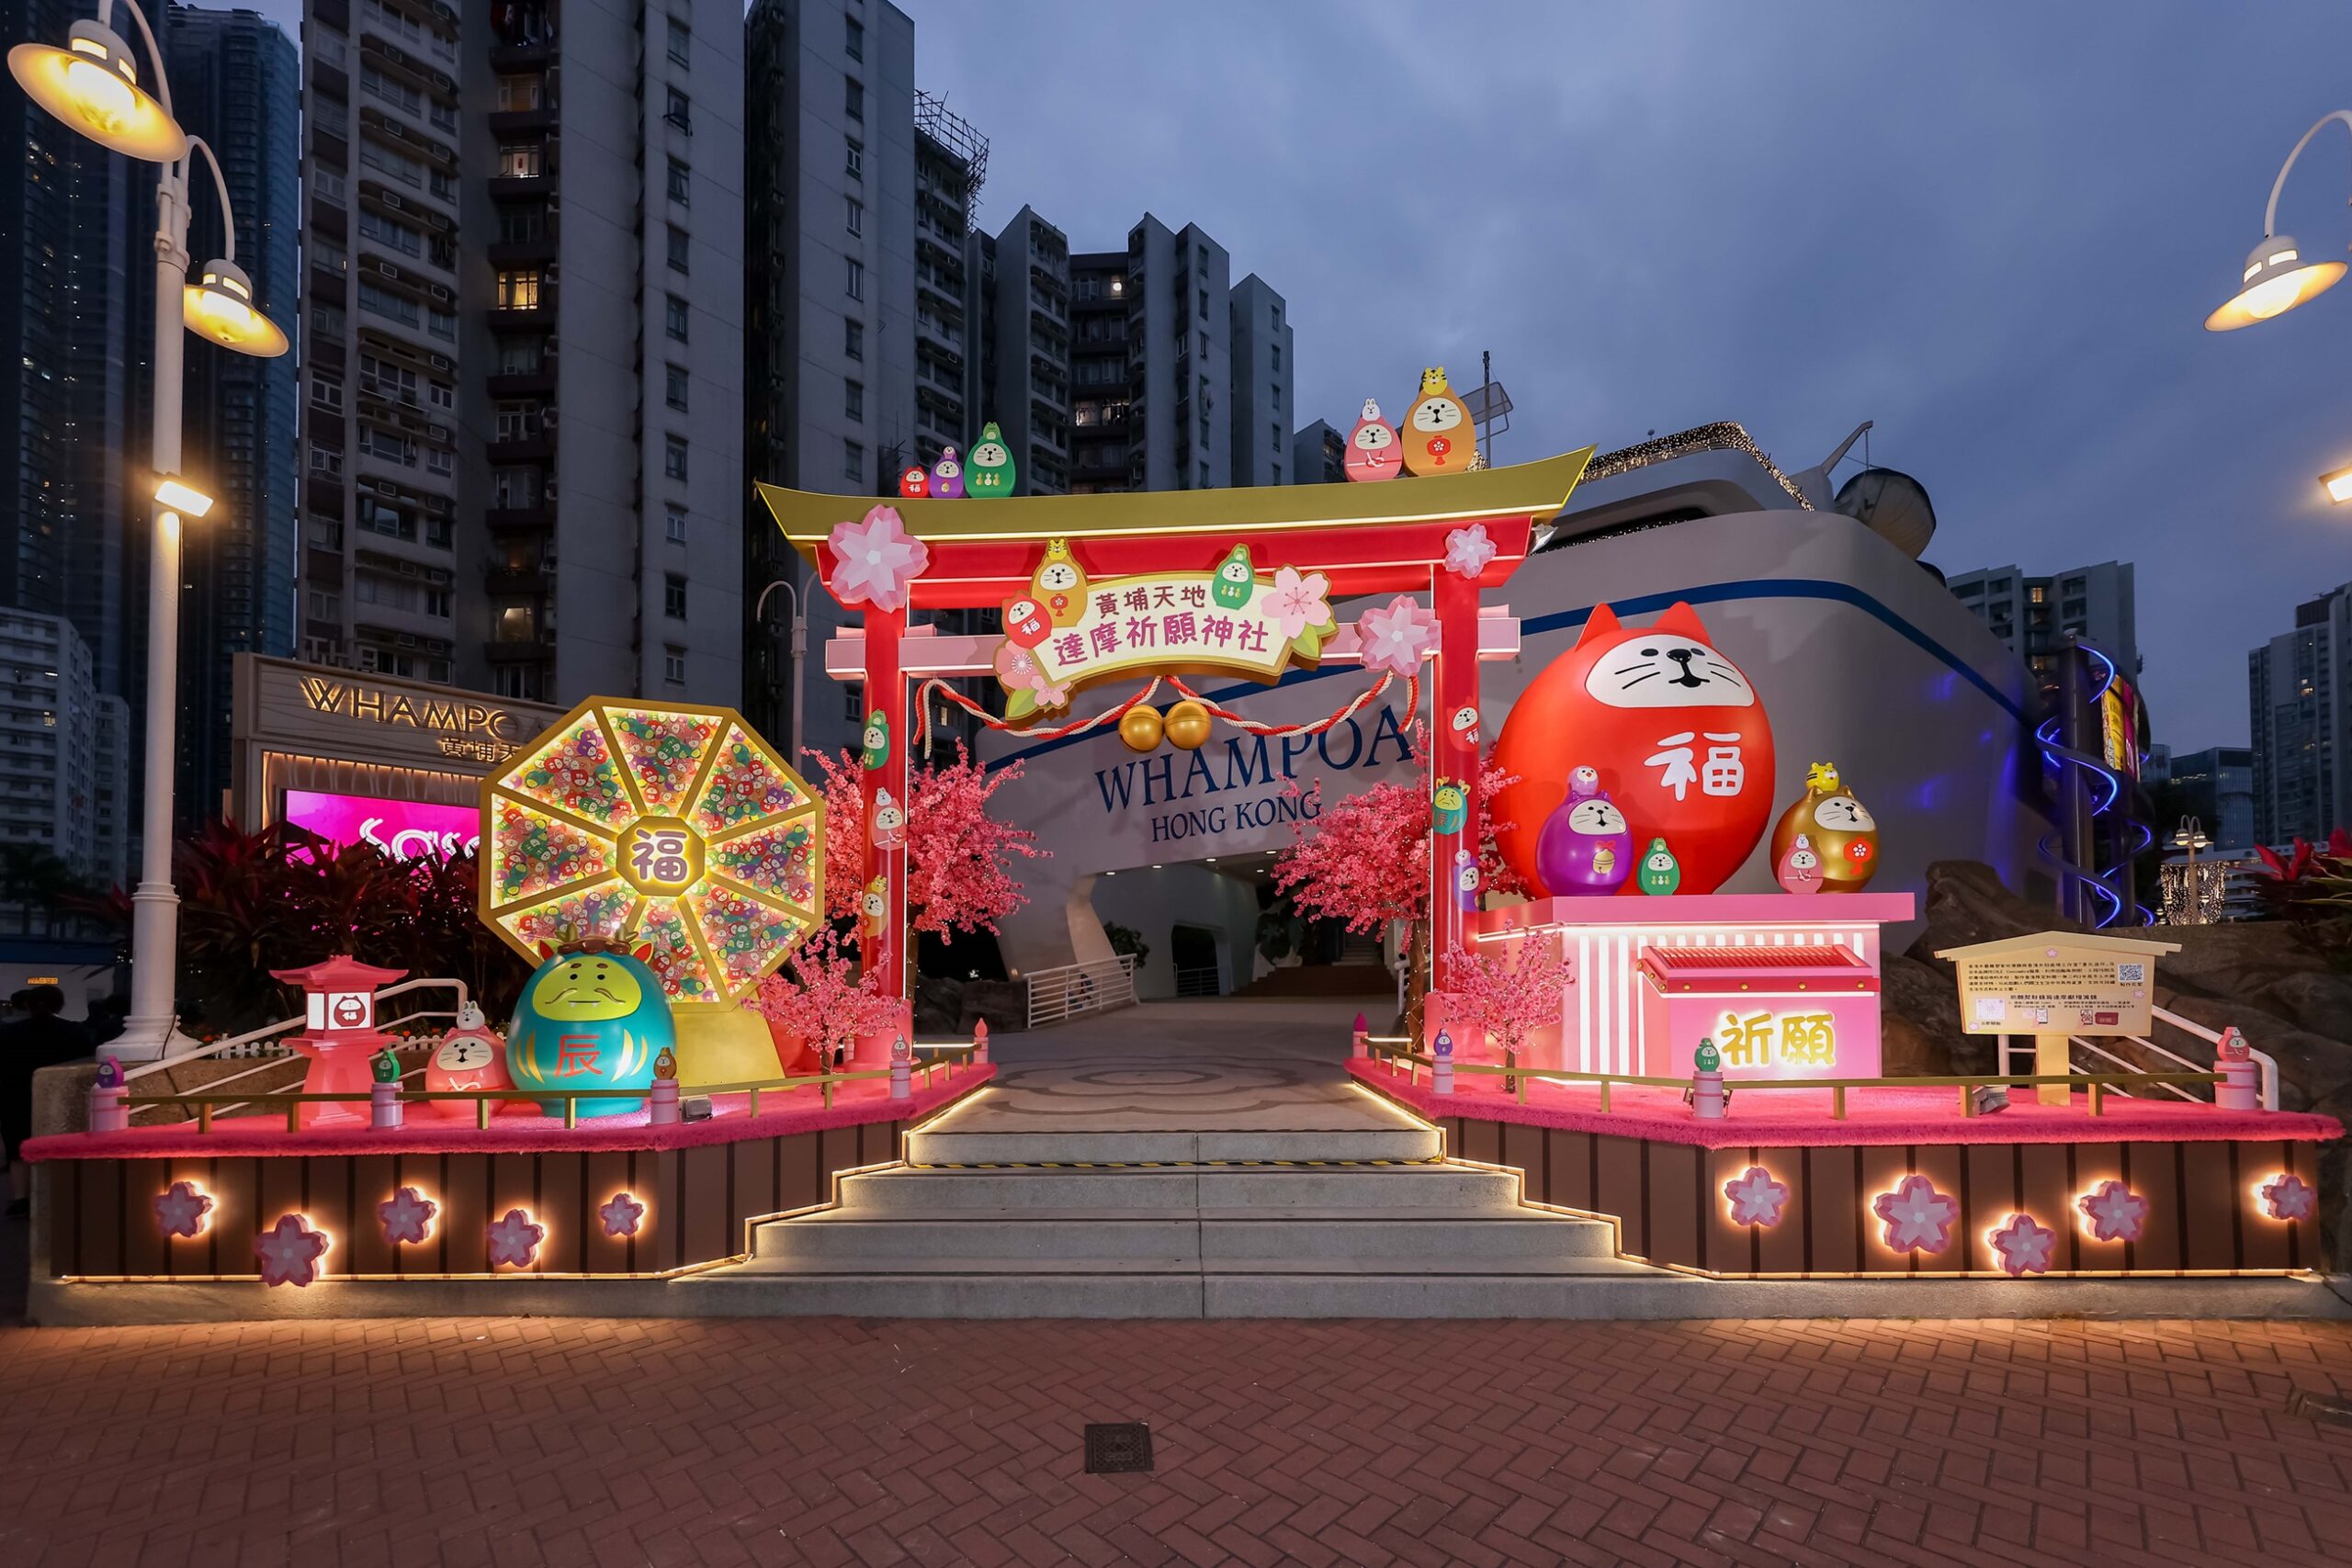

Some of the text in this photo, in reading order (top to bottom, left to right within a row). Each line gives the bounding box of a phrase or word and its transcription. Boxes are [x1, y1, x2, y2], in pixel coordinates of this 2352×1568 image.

[1021, 617, 1041, 636] 福
[1095, 584, 1206, 619] 黃埔天地
[1052, 612, 1269, 666] 達摩祈願神社
[1094, 705, 1415, 814] WHAMPOA
[1644, 731, 1745, 801] 福
[1151, 791, 1323, 842] HONG KONG
[632, 829, 687, 882] 福
[554, 1034, 603, 1078] 辰
[1721, 1013, 1834, 1066] 祈願
